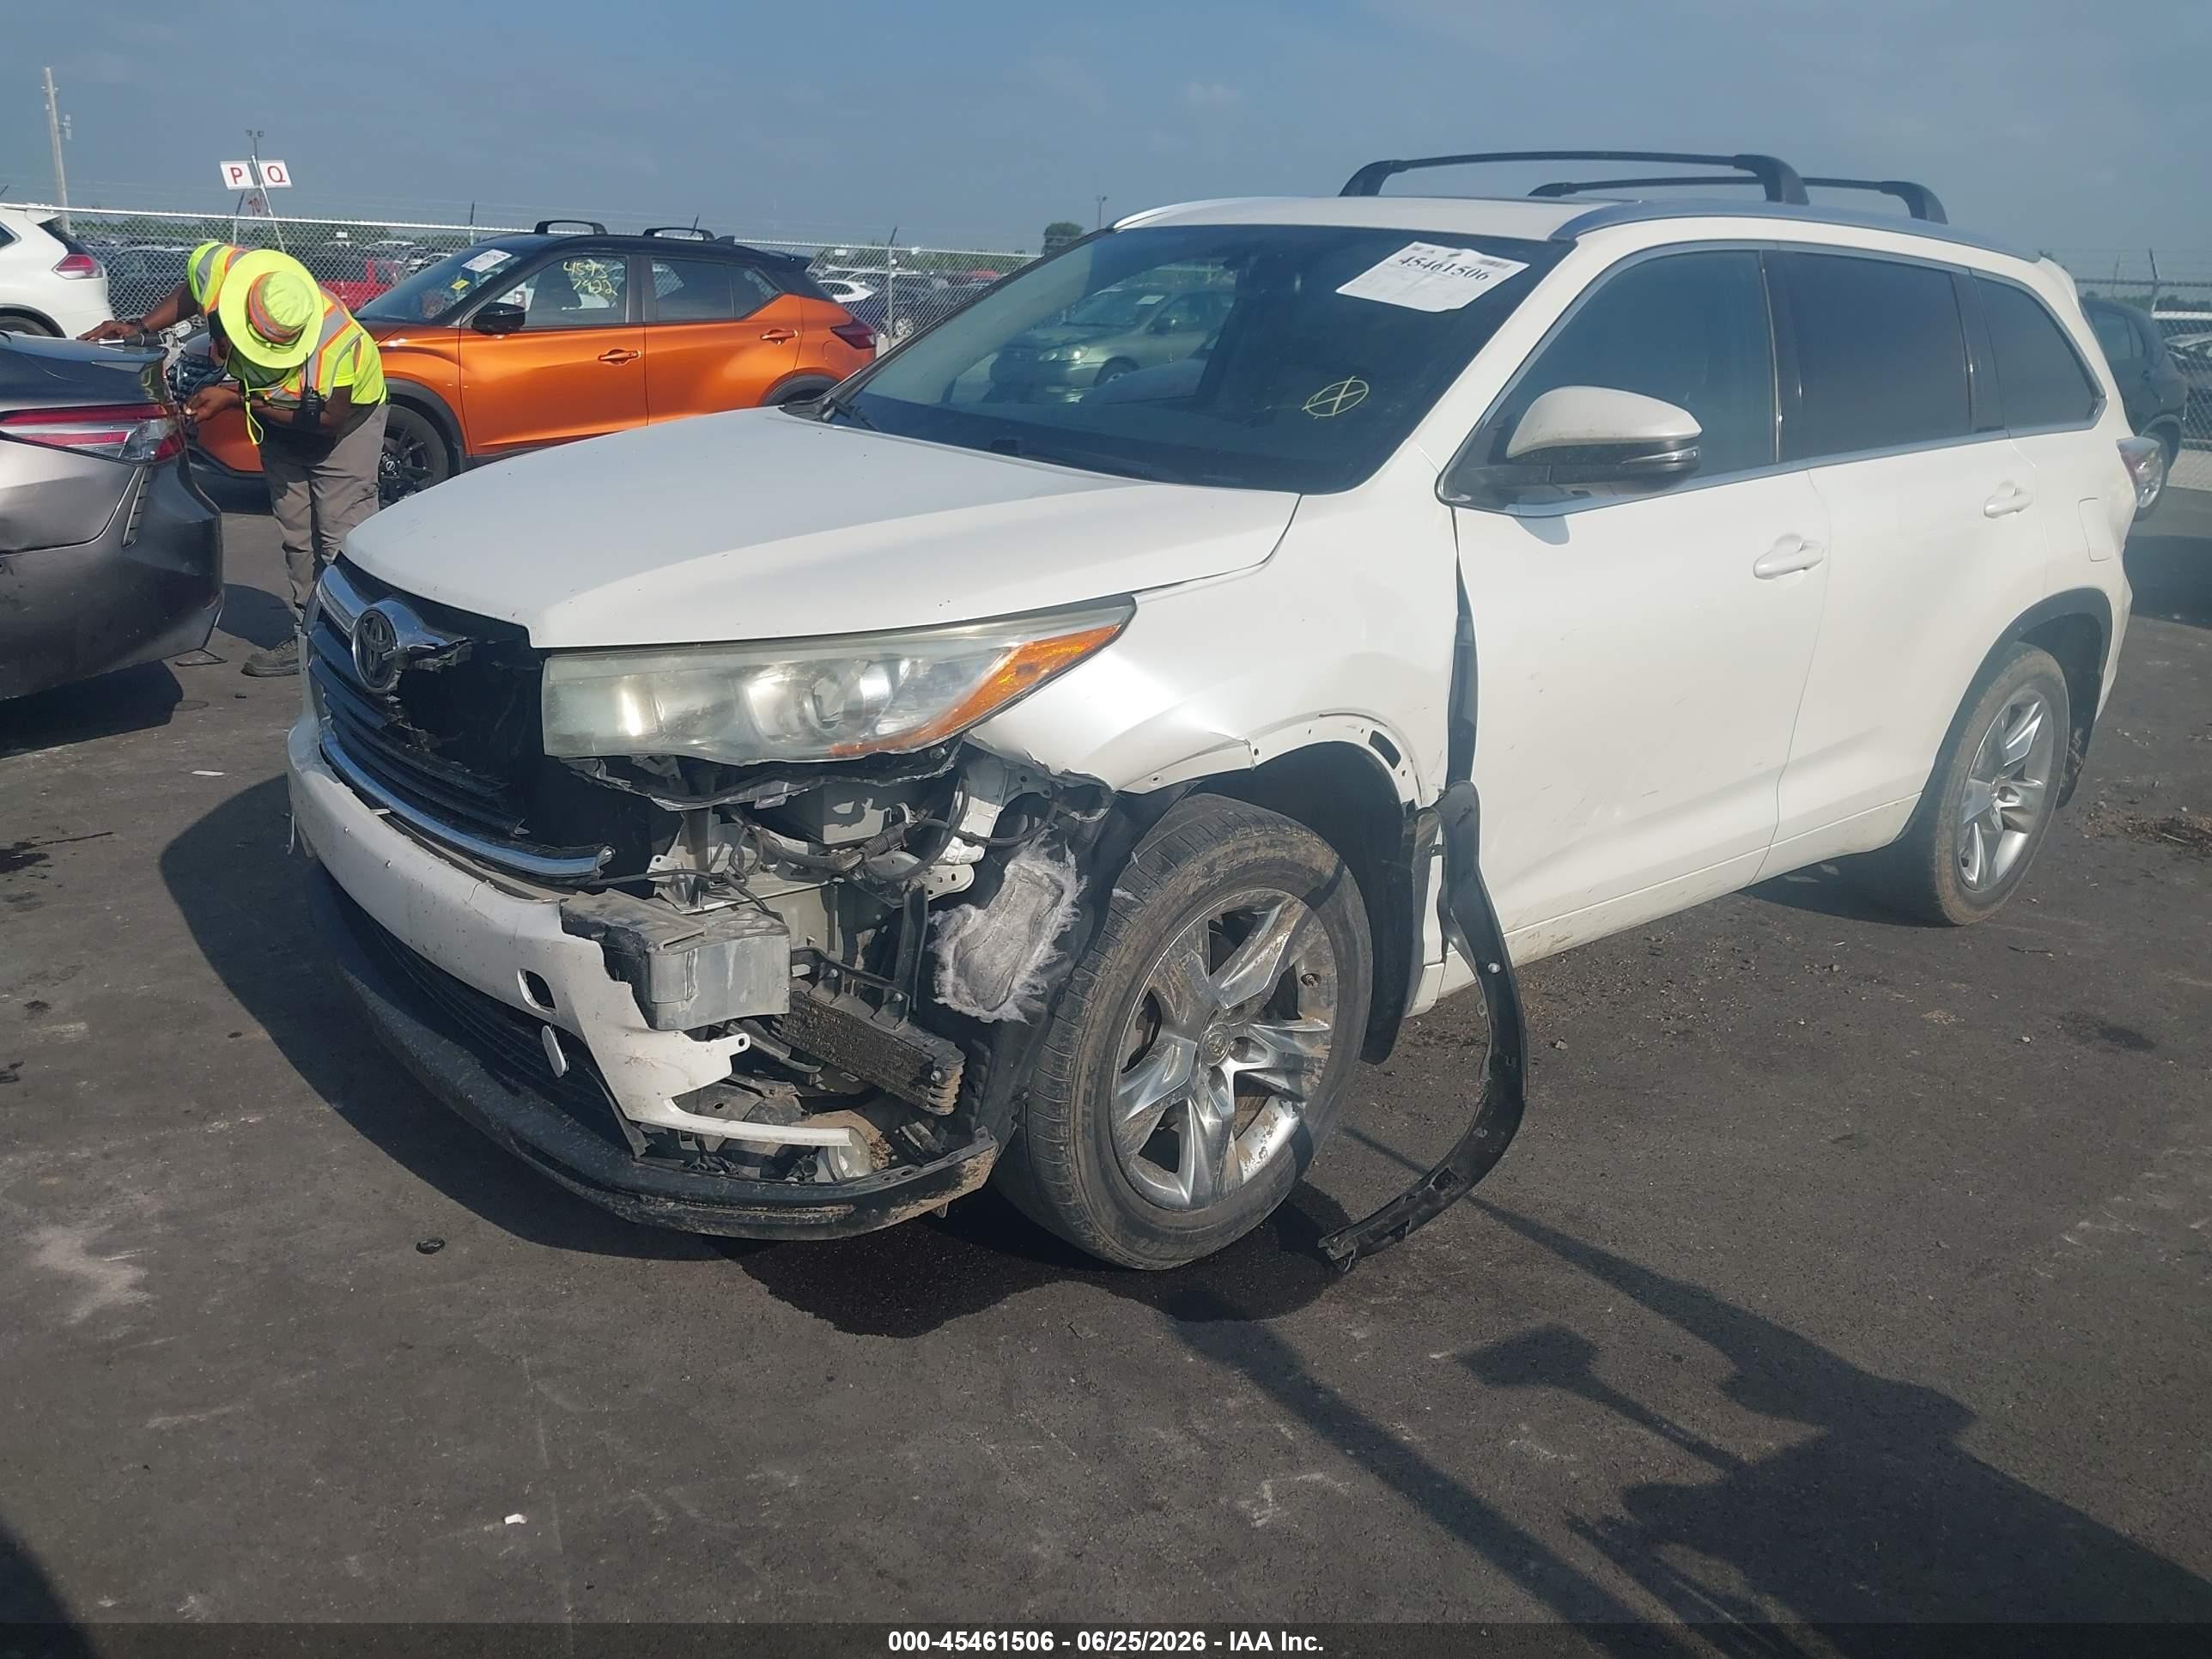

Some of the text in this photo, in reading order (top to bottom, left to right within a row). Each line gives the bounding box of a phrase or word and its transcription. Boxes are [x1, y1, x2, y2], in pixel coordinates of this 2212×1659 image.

[230, 167, 243, 185] P
[267, 165, 286, 183] Q
[1399, 256, 1490, 281] 45461506
